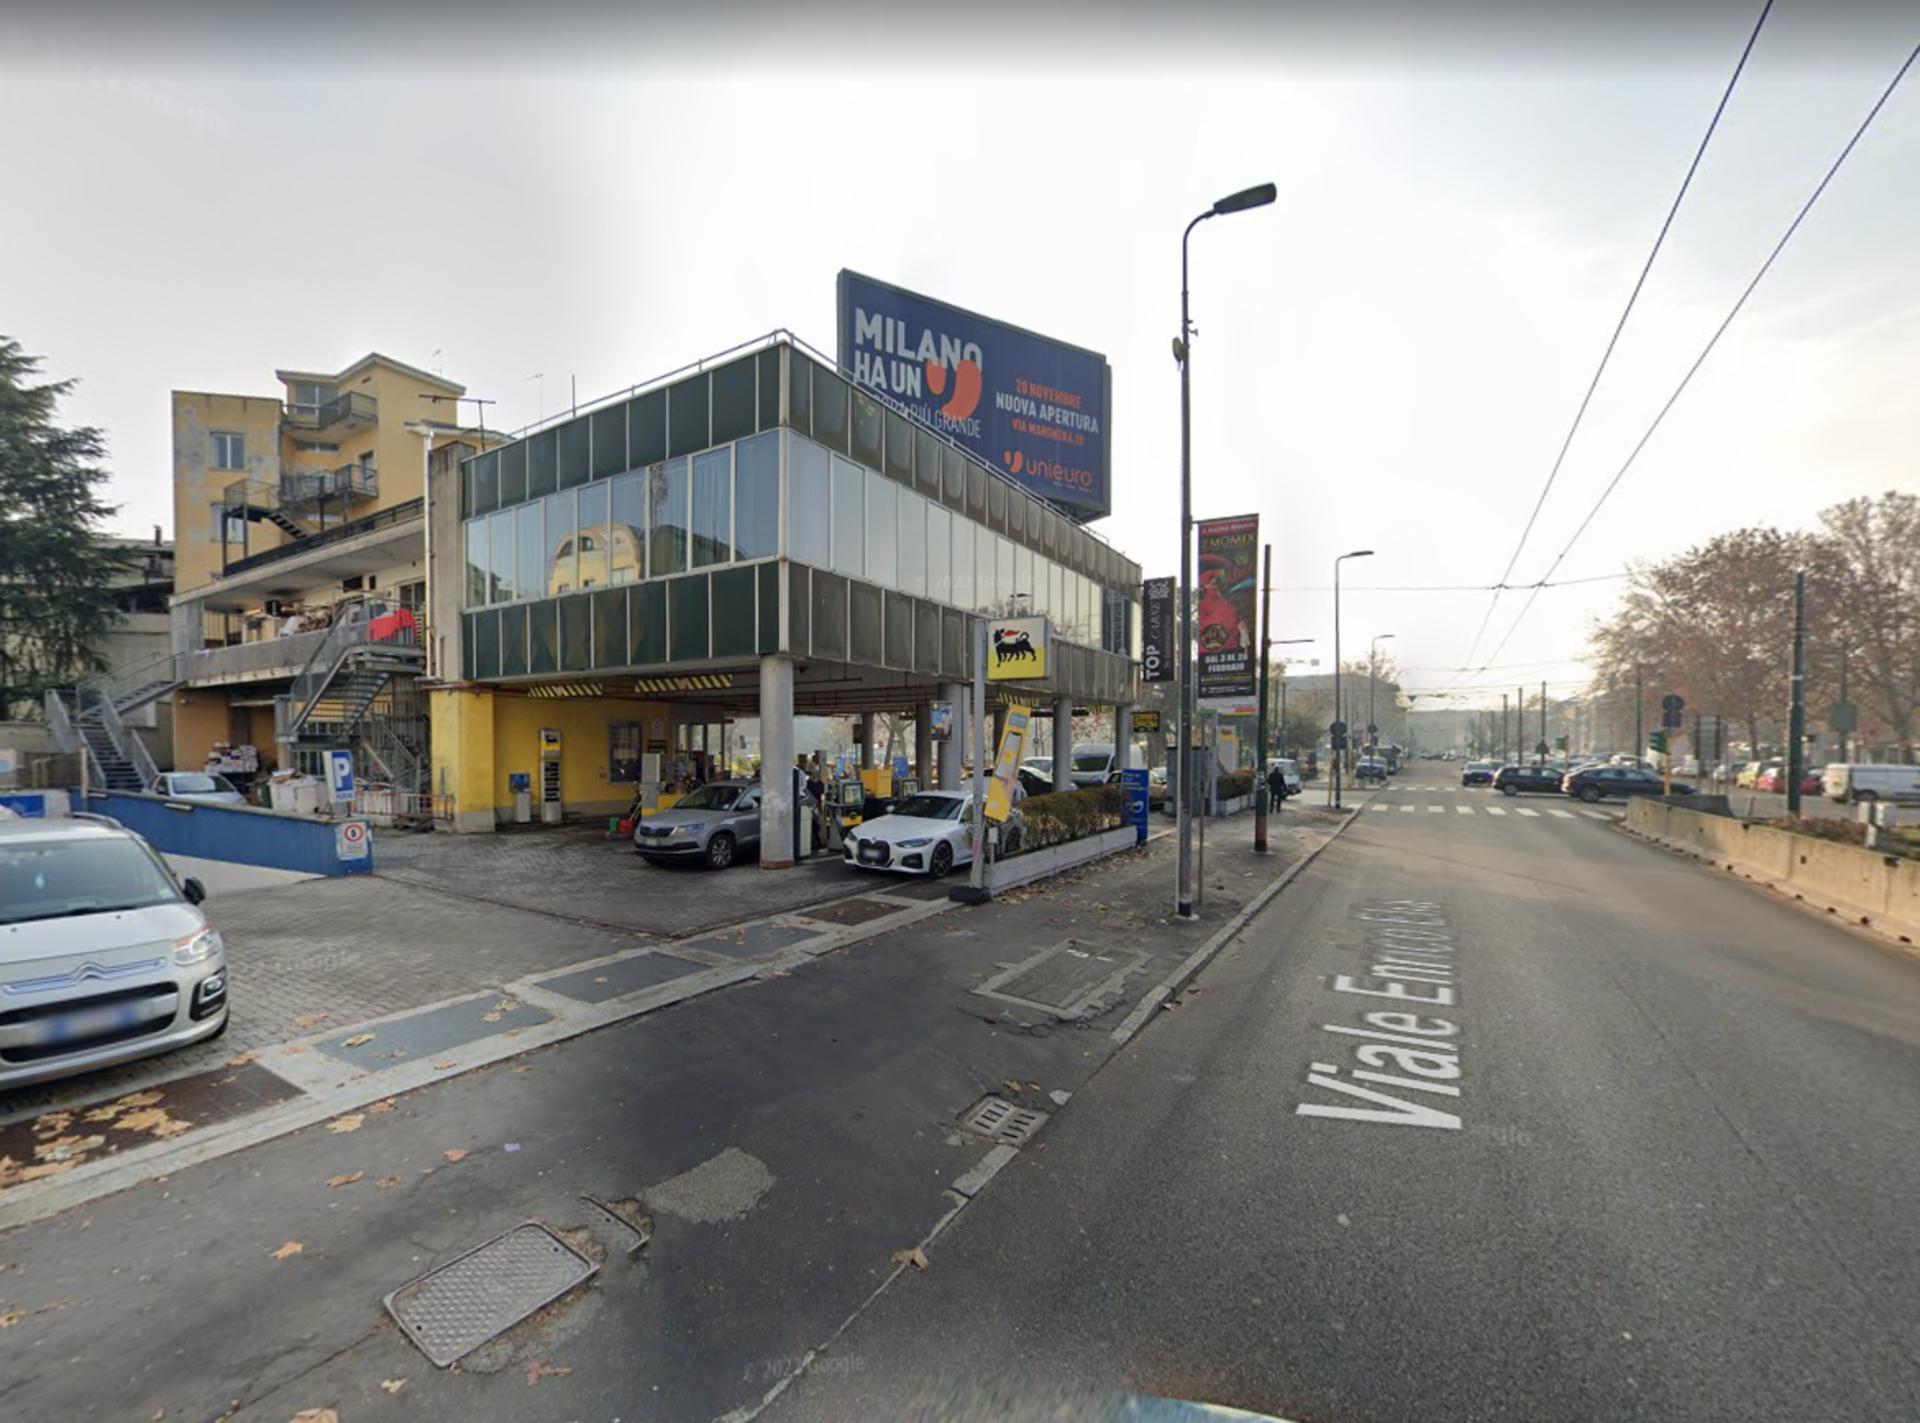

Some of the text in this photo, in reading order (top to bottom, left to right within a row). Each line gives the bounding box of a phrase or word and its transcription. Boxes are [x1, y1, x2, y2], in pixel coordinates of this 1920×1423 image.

[855, 307, 983, 372] MILANO
[855, 350, 922, 398] HA UN
[934, 409, 982, 439] GRANDE
[995, 391, 1099, 433] NUOVA APERTURA
[1011, 417, 1027, 432] VIA
[1026, 458, 1093, 487] unieuro
[1145, 643, 1160, 680] TOP
[334, 757, 350, 789] P
